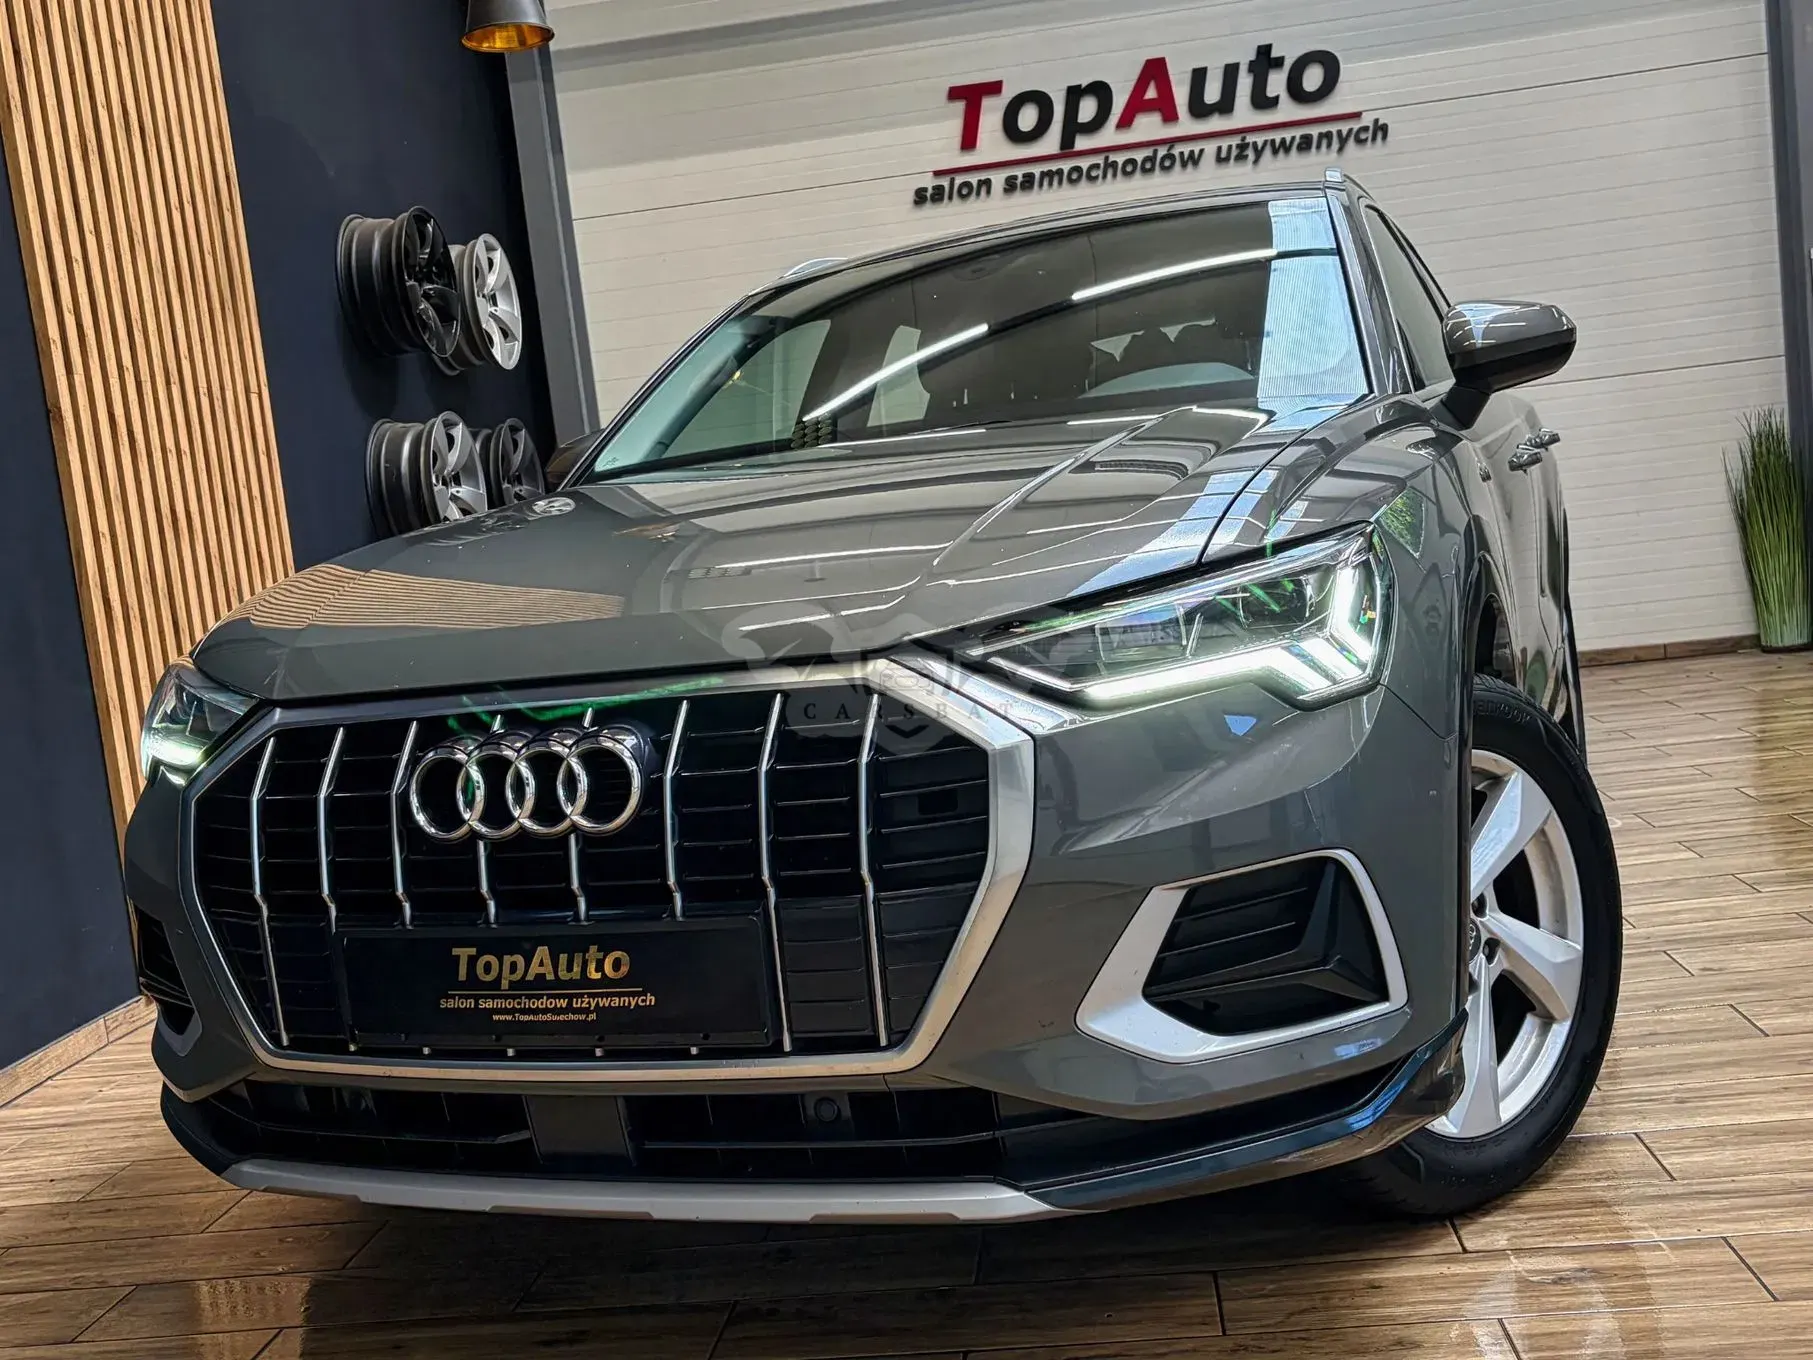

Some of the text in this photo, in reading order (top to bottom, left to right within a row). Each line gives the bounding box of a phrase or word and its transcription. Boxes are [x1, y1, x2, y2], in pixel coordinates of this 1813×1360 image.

[948, 43, 1341, 152] TopAuto
[913, 118, 1389, 205] salon samochodów używanych
[452, 945, 630, 990] TopAuto
[440, 996, 475, 1009] salon
[572, 993, 656, 1010] używanych
